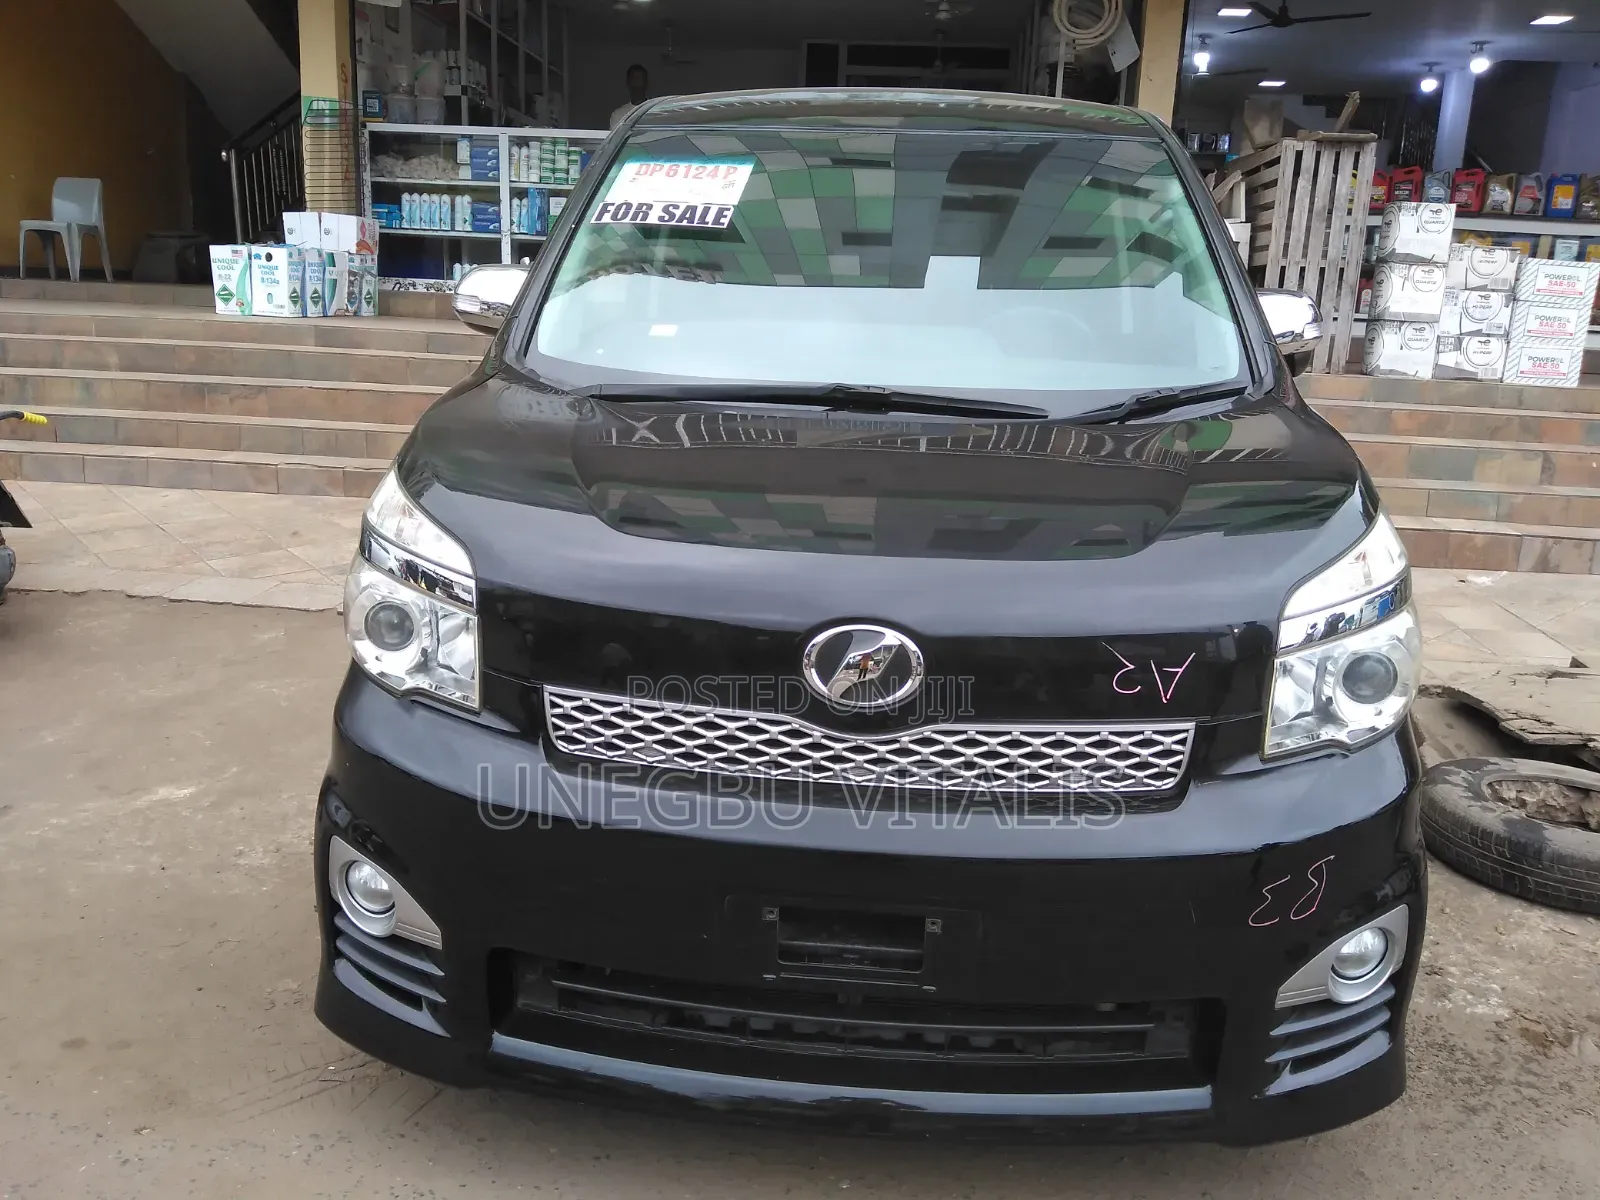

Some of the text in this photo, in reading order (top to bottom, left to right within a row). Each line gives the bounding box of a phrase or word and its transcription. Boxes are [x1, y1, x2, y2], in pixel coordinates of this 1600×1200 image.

[594, 201, 732, 227] FOR SALE
[212, 257, 240, 265] UNIQUE
[257, 264, 279, 272] UNIQUE
[1547, 280, 1576, 288] SAE-50
[1538, 321, 1567, 329] SAE-50
